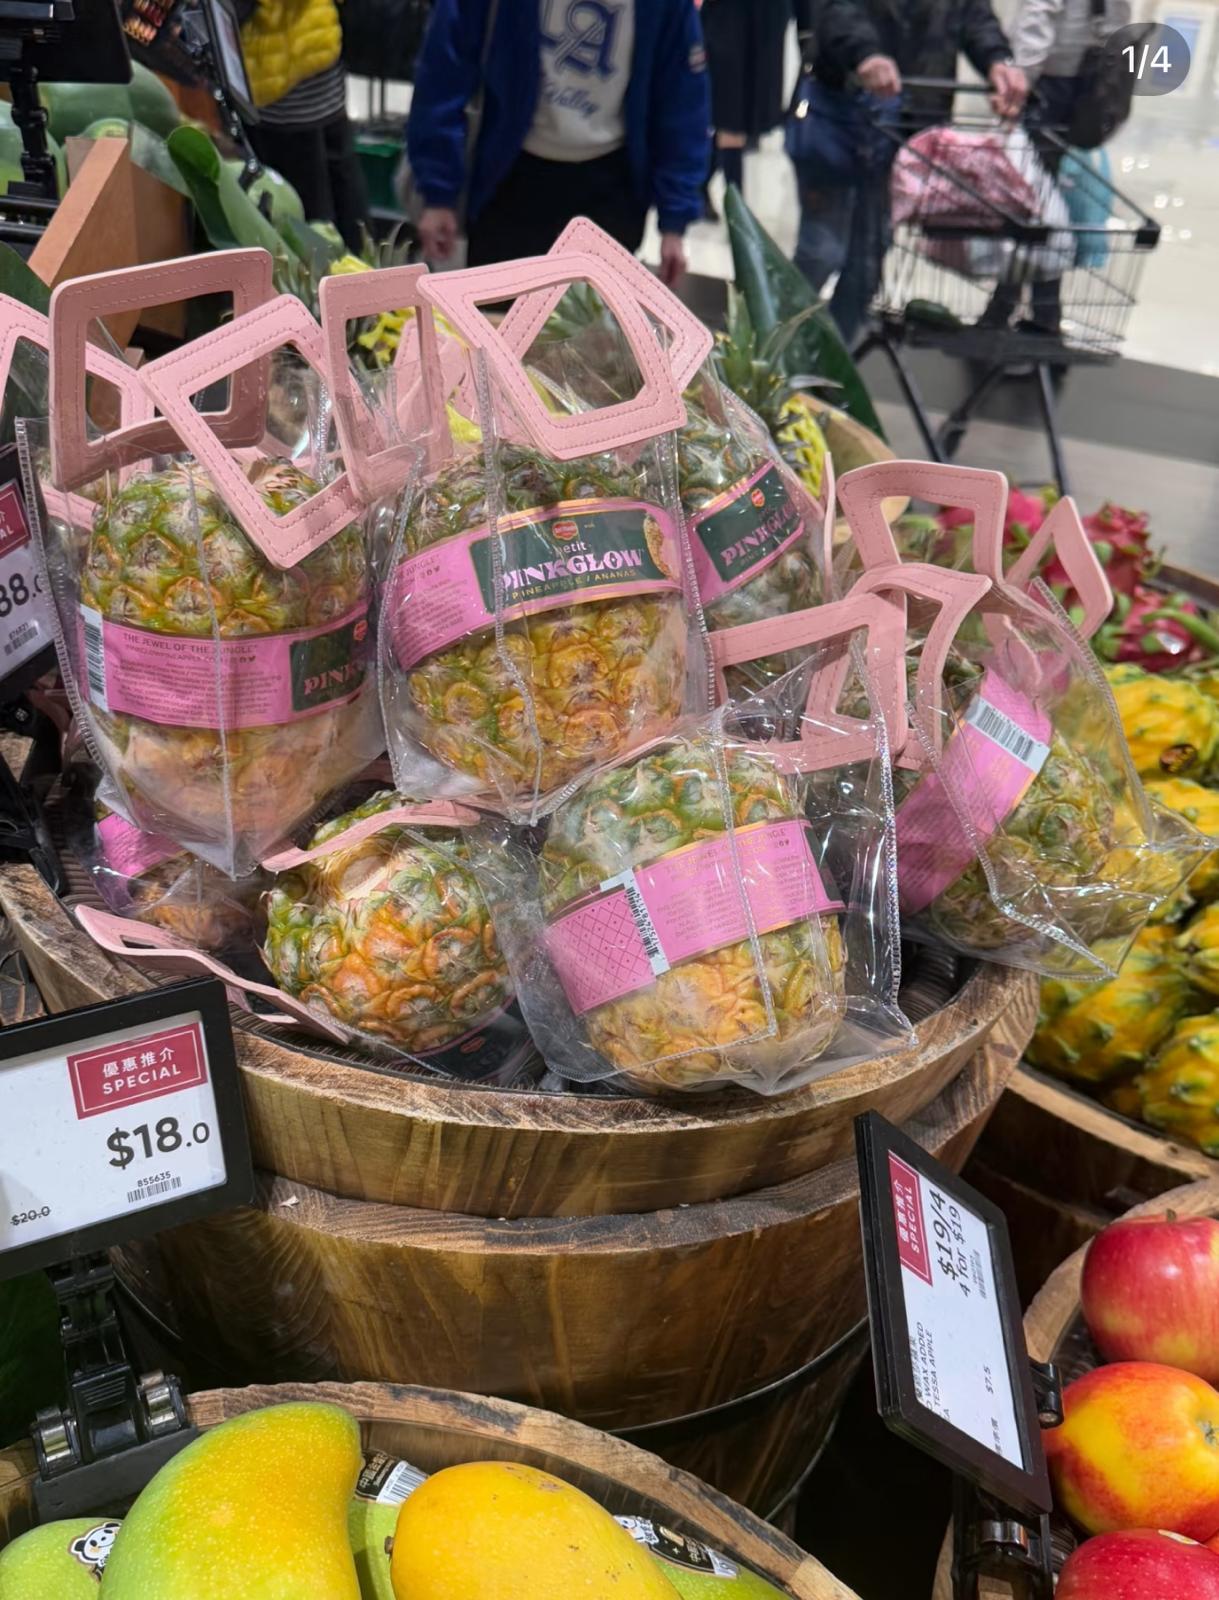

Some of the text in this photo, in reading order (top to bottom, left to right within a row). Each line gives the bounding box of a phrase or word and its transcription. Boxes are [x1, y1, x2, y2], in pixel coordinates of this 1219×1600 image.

[502, 549, 644, 590] PINKGLOW
[594, 568, 637, 582] ANANAS
[124, 633, 141, 645] THE
[143, 637, 171, 650] JEWEL
[173, 643, 185, 652] OF
[190, 645, 209, 654] THE
[102, 1047, 175, 1078] 優惠推介
[103, 1064, 181, 1095] SPECIAL
[106, 1116, 210, 1170] $18.0
[136, 1171, 172, 1188] 855635
[904, 1186, 920, 1254] SPECIAL
[929, 1188, 960, 1281] $19/4
[948, 1205, 971, 1297] 4 for $19
[916, 1321, 928, 1367] ADDED
[921, 1368, 931, 1397] WAX
[924, 1329, 941, 1407] TESSA APPLE
